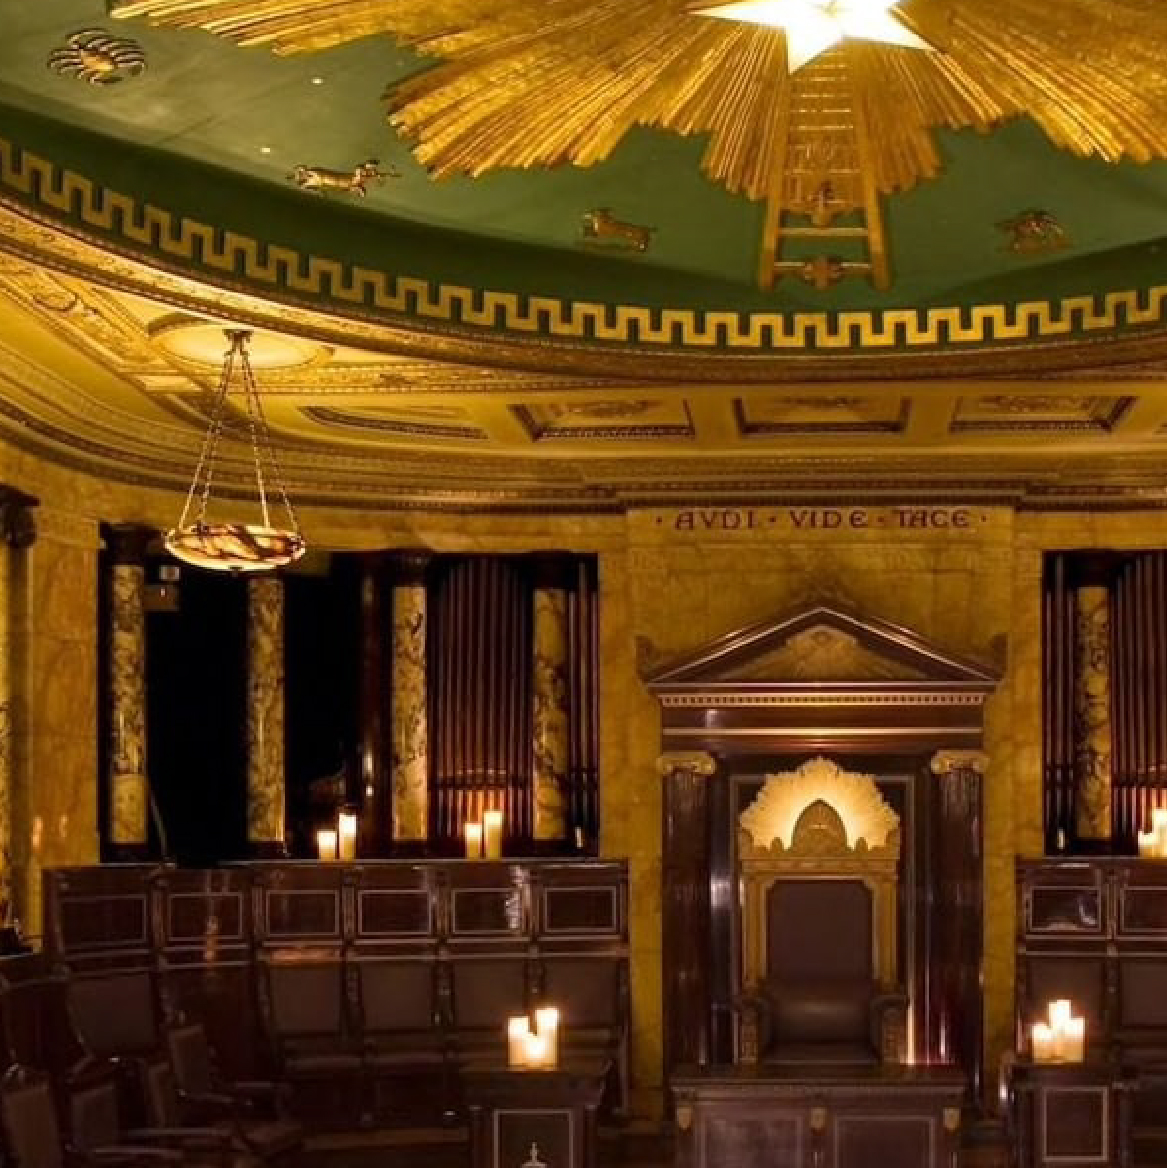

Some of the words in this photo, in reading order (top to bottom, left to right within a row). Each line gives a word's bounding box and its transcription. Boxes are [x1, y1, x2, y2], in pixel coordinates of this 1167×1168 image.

[674, 508, 755, 530] AVDI
[789, 508, 869, 529] VIDE
[898, 508, 971, 529] TACE
